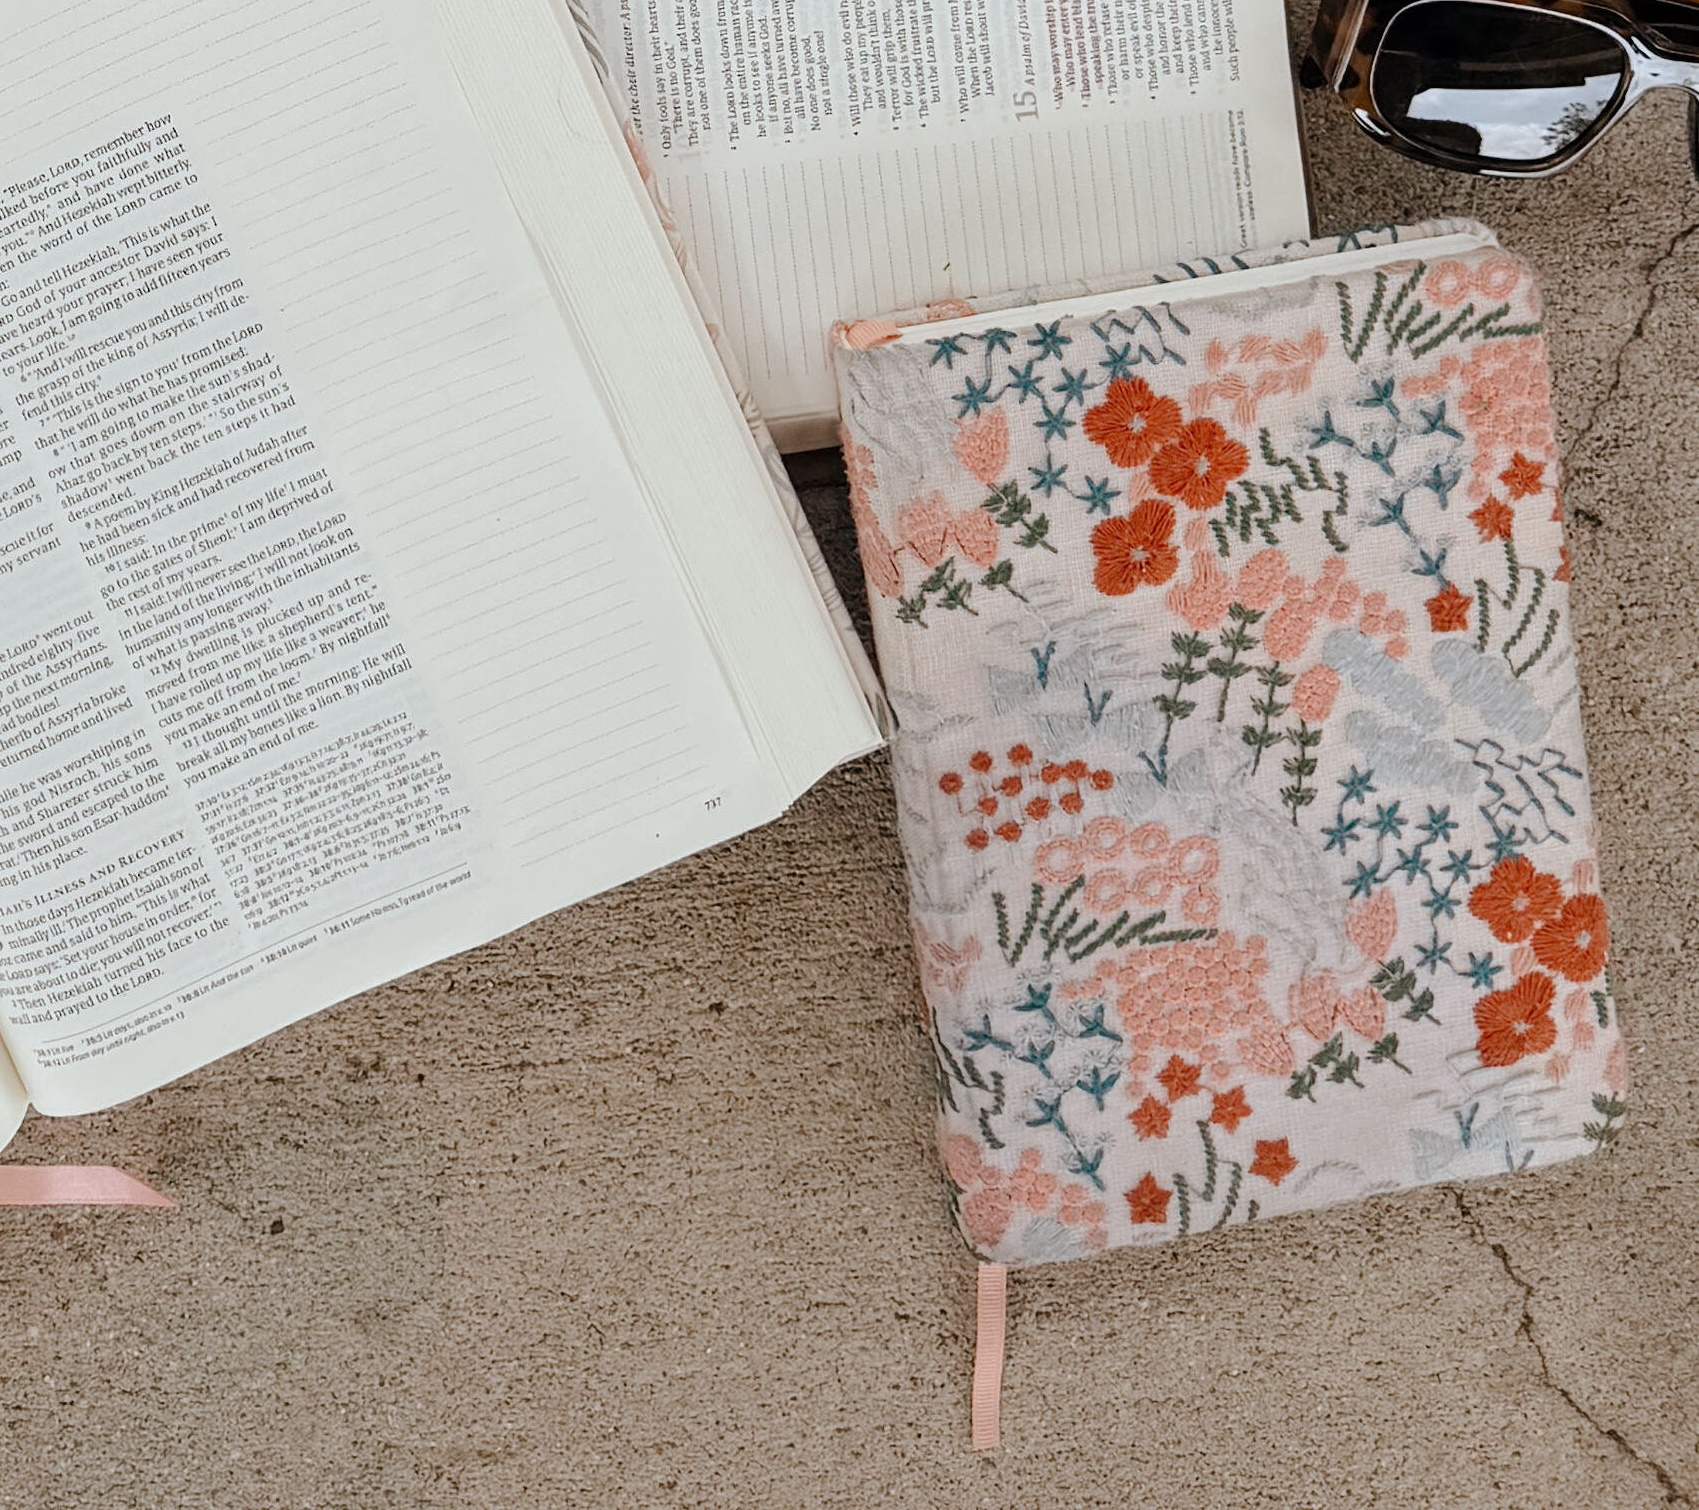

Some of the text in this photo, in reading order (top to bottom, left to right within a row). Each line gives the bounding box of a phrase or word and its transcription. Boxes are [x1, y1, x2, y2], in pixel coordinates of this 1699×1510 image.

[1011, 90, 1039, 122] 15
[33, 878, 86, 906] ILLNESS
[89, 863, 116, 883] AND
[117, 829, 184, 868] RECOVERY
